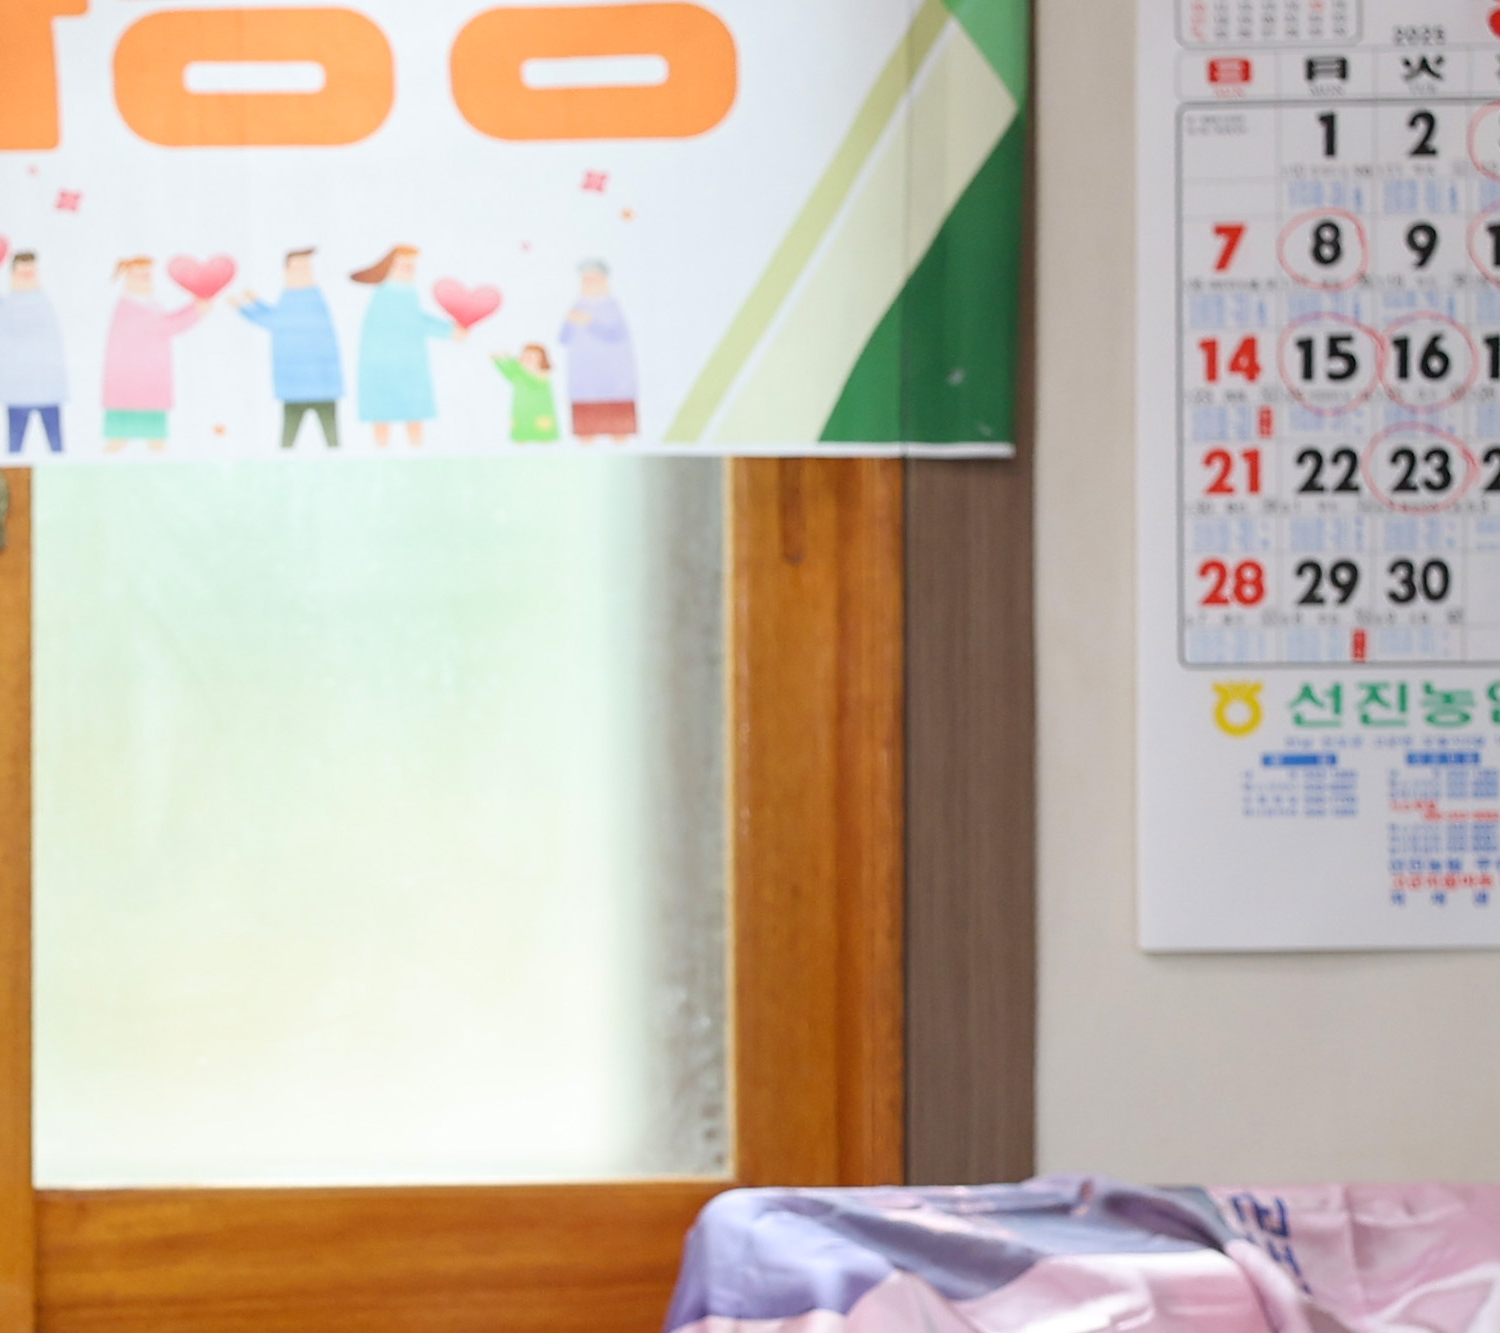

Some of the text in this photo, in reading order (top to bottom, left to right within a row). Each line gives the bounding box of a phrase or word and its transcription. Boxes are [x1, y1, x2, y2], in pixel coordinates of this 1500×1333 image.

[1318, 111, 1338, 157] 1
[1408, 110, 1439, 157] 2
[1213, 222, 1247, 273] 7
[1312, 220, 1342, 266] 8
[1405, 222, 1439, 269] 9
[1198, 335, 1262, 383] 14
[1296, 336, 1358, 381] 15
[1392, 334, 1451, 380] 16
[1203, 447, 1261, 494] 21
[1296, 448, 1360, 493] 22
[1390, 448, 1452, 492] 23
[1199, 559, 1266, 606] 28
[1296, 560, 1360, 606] 29
[1387, 560, 1451, 603] 30
[1288, 682, 1500, 729] 선진농
